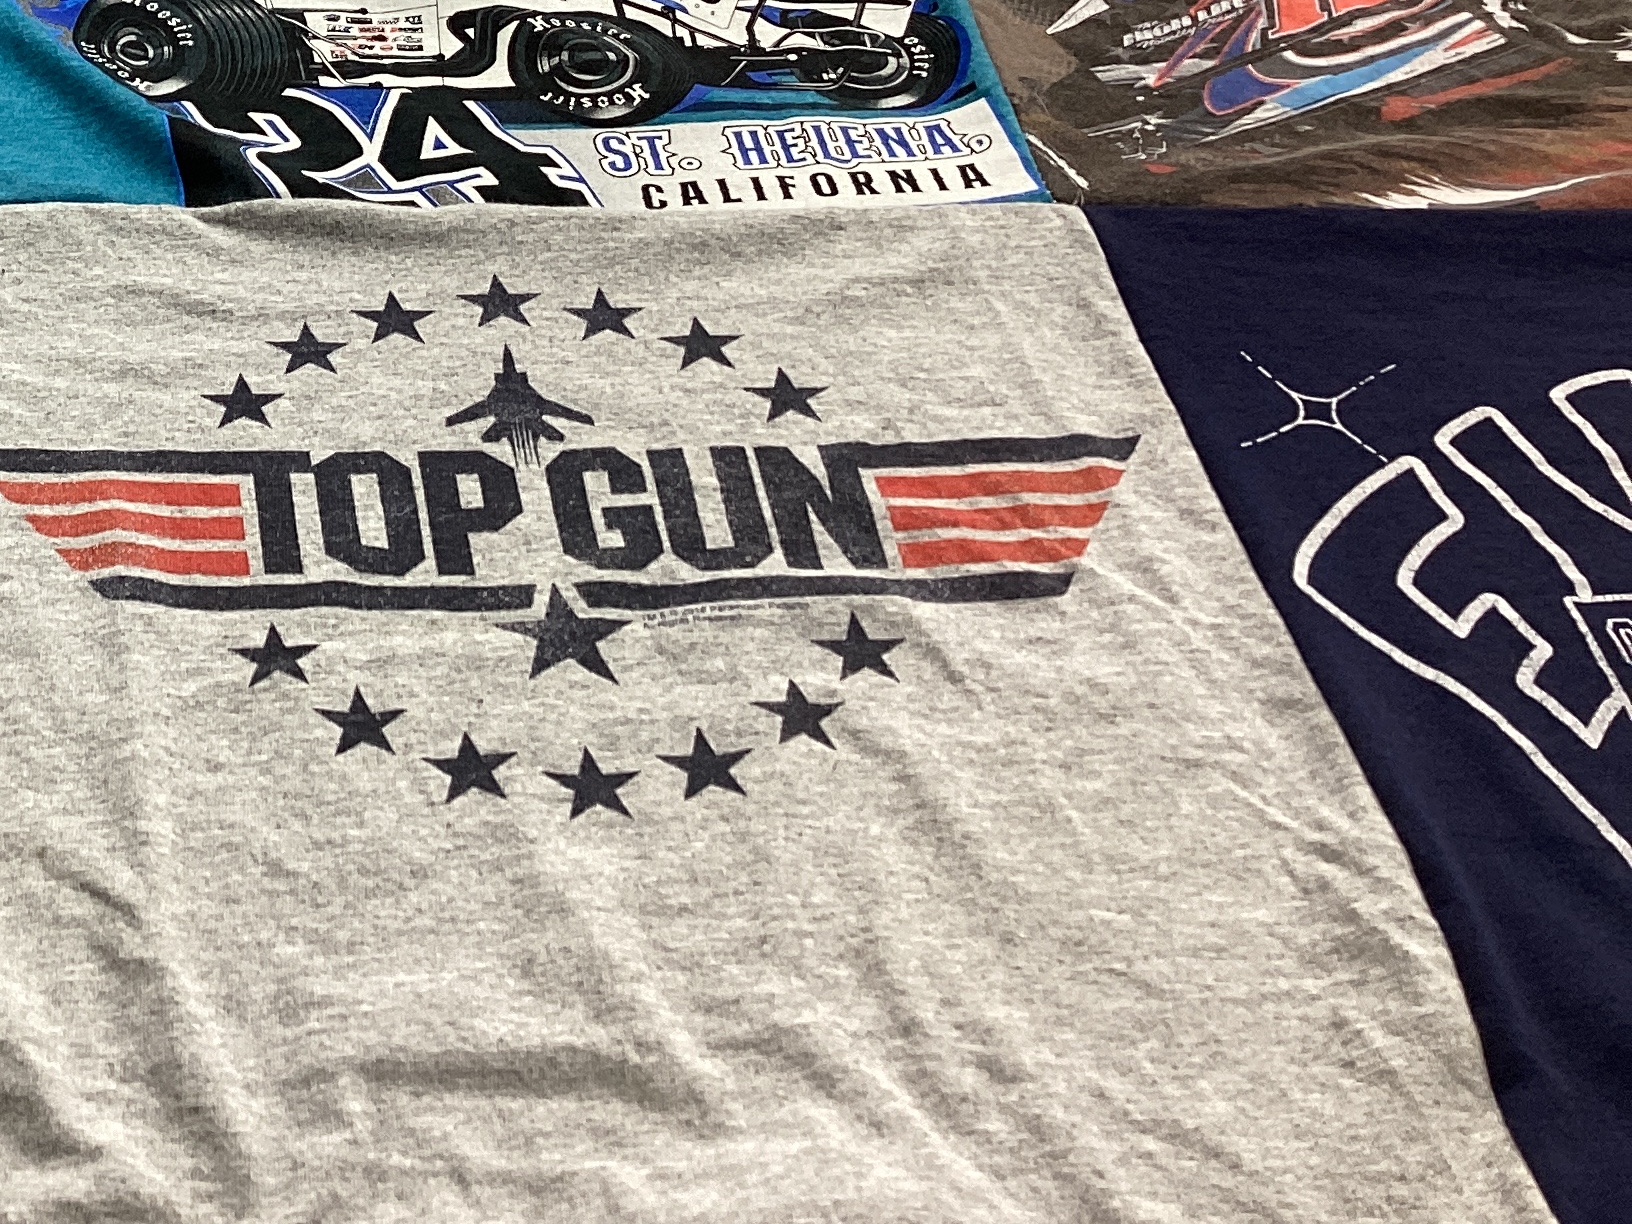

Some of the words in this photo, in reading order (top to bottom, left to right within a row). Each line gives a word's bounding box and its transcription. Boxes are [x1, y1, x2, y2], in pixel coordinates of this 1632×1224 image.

[526, 14, 632, 41] Hoosier
[903, 35, 929, 80] osier
[180, 86, 606, 208] 24
[594, 128, 703, 179] ST.
[641, 162, 992, 211] CALIFORNIA
[244, 448, 525, 578] TOP
[545, 444, 898, 576] GUN
